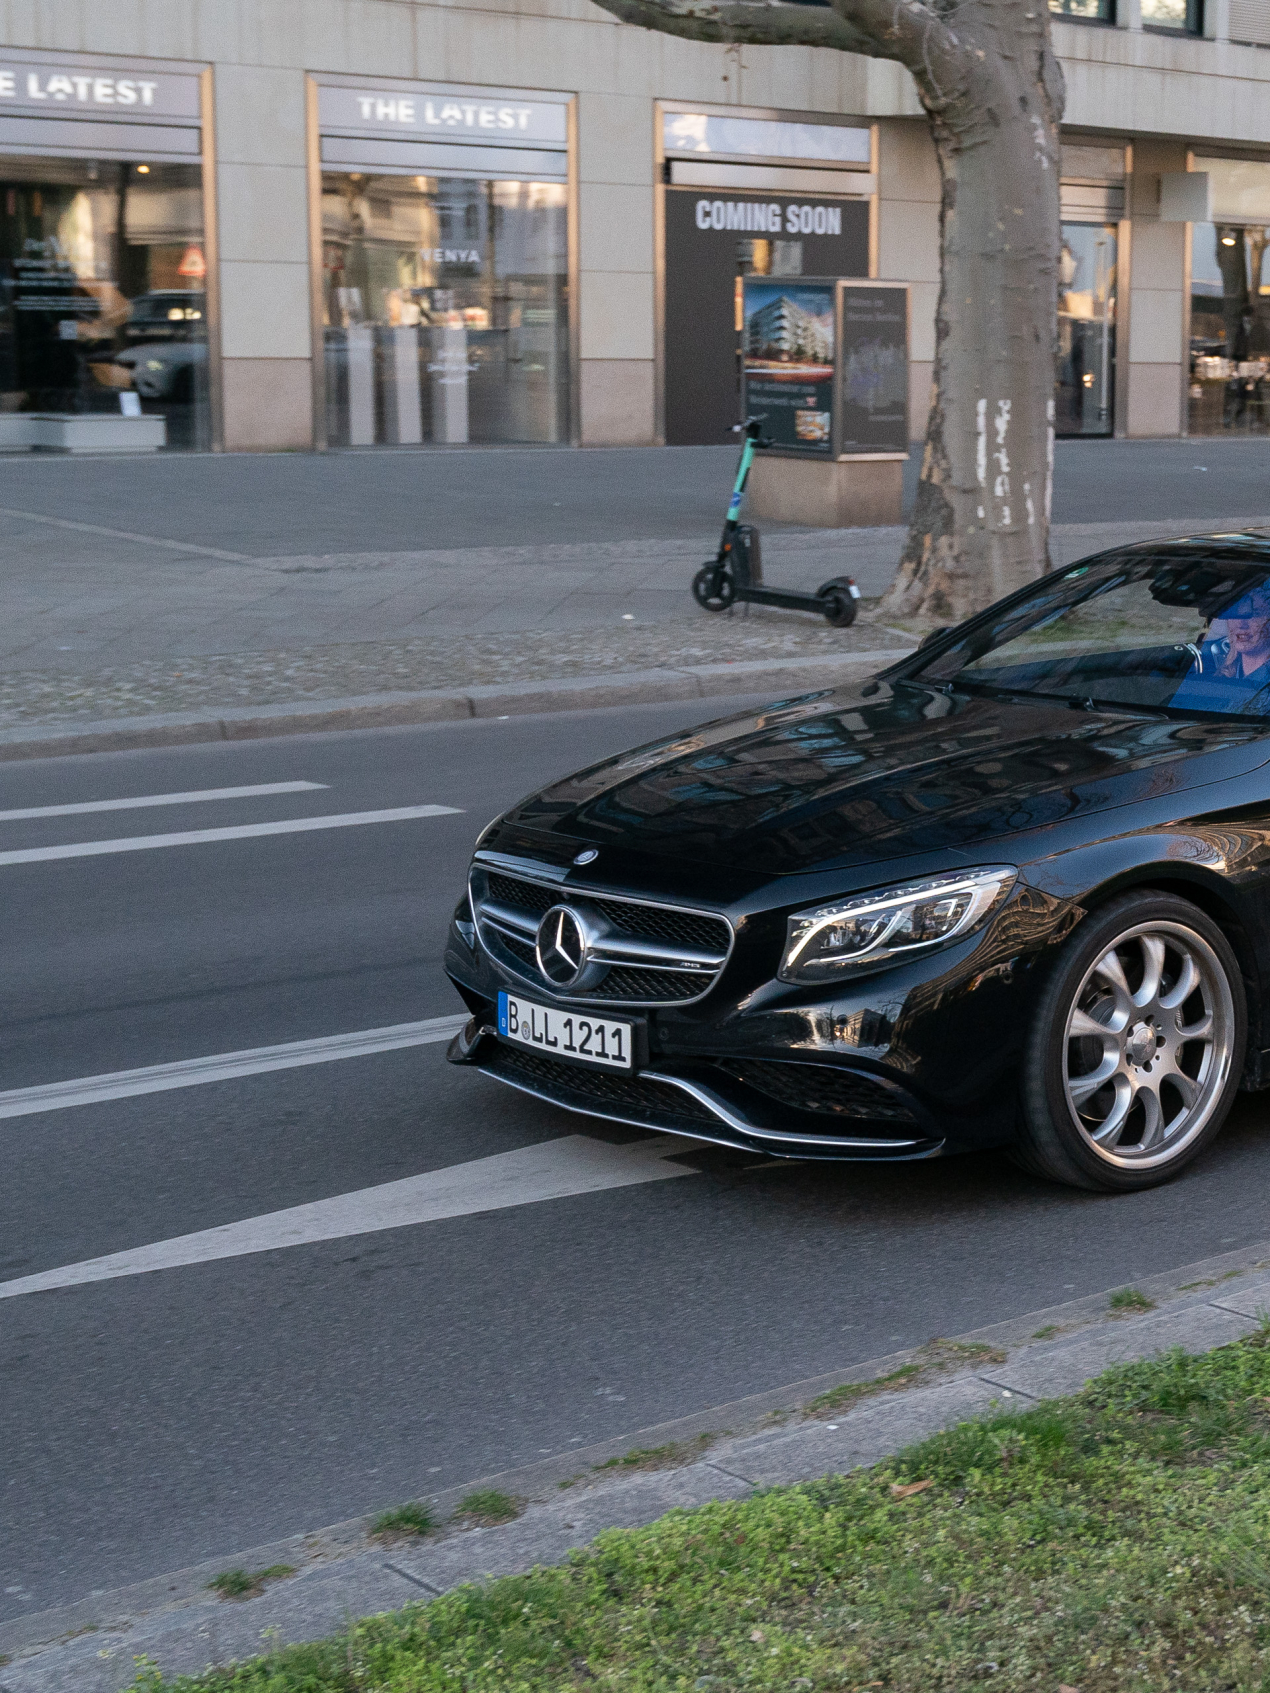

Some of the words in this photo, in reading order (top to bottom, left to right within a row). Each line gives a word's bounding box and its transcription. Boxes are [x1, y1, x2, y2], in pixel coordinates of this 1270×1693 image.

[27, 73, 159, 107] LATEST
[357, 96, 416, 124] THE
[423, 101, 533, 130] LATEST
[695, 199, 782, 233] COMING
[785, 204, 842, 235] SOON
[508, 1000, 519, 1035] B
[531, 1007, 558, 1047] LL
[563, 1017, 627, 1063] 1211
